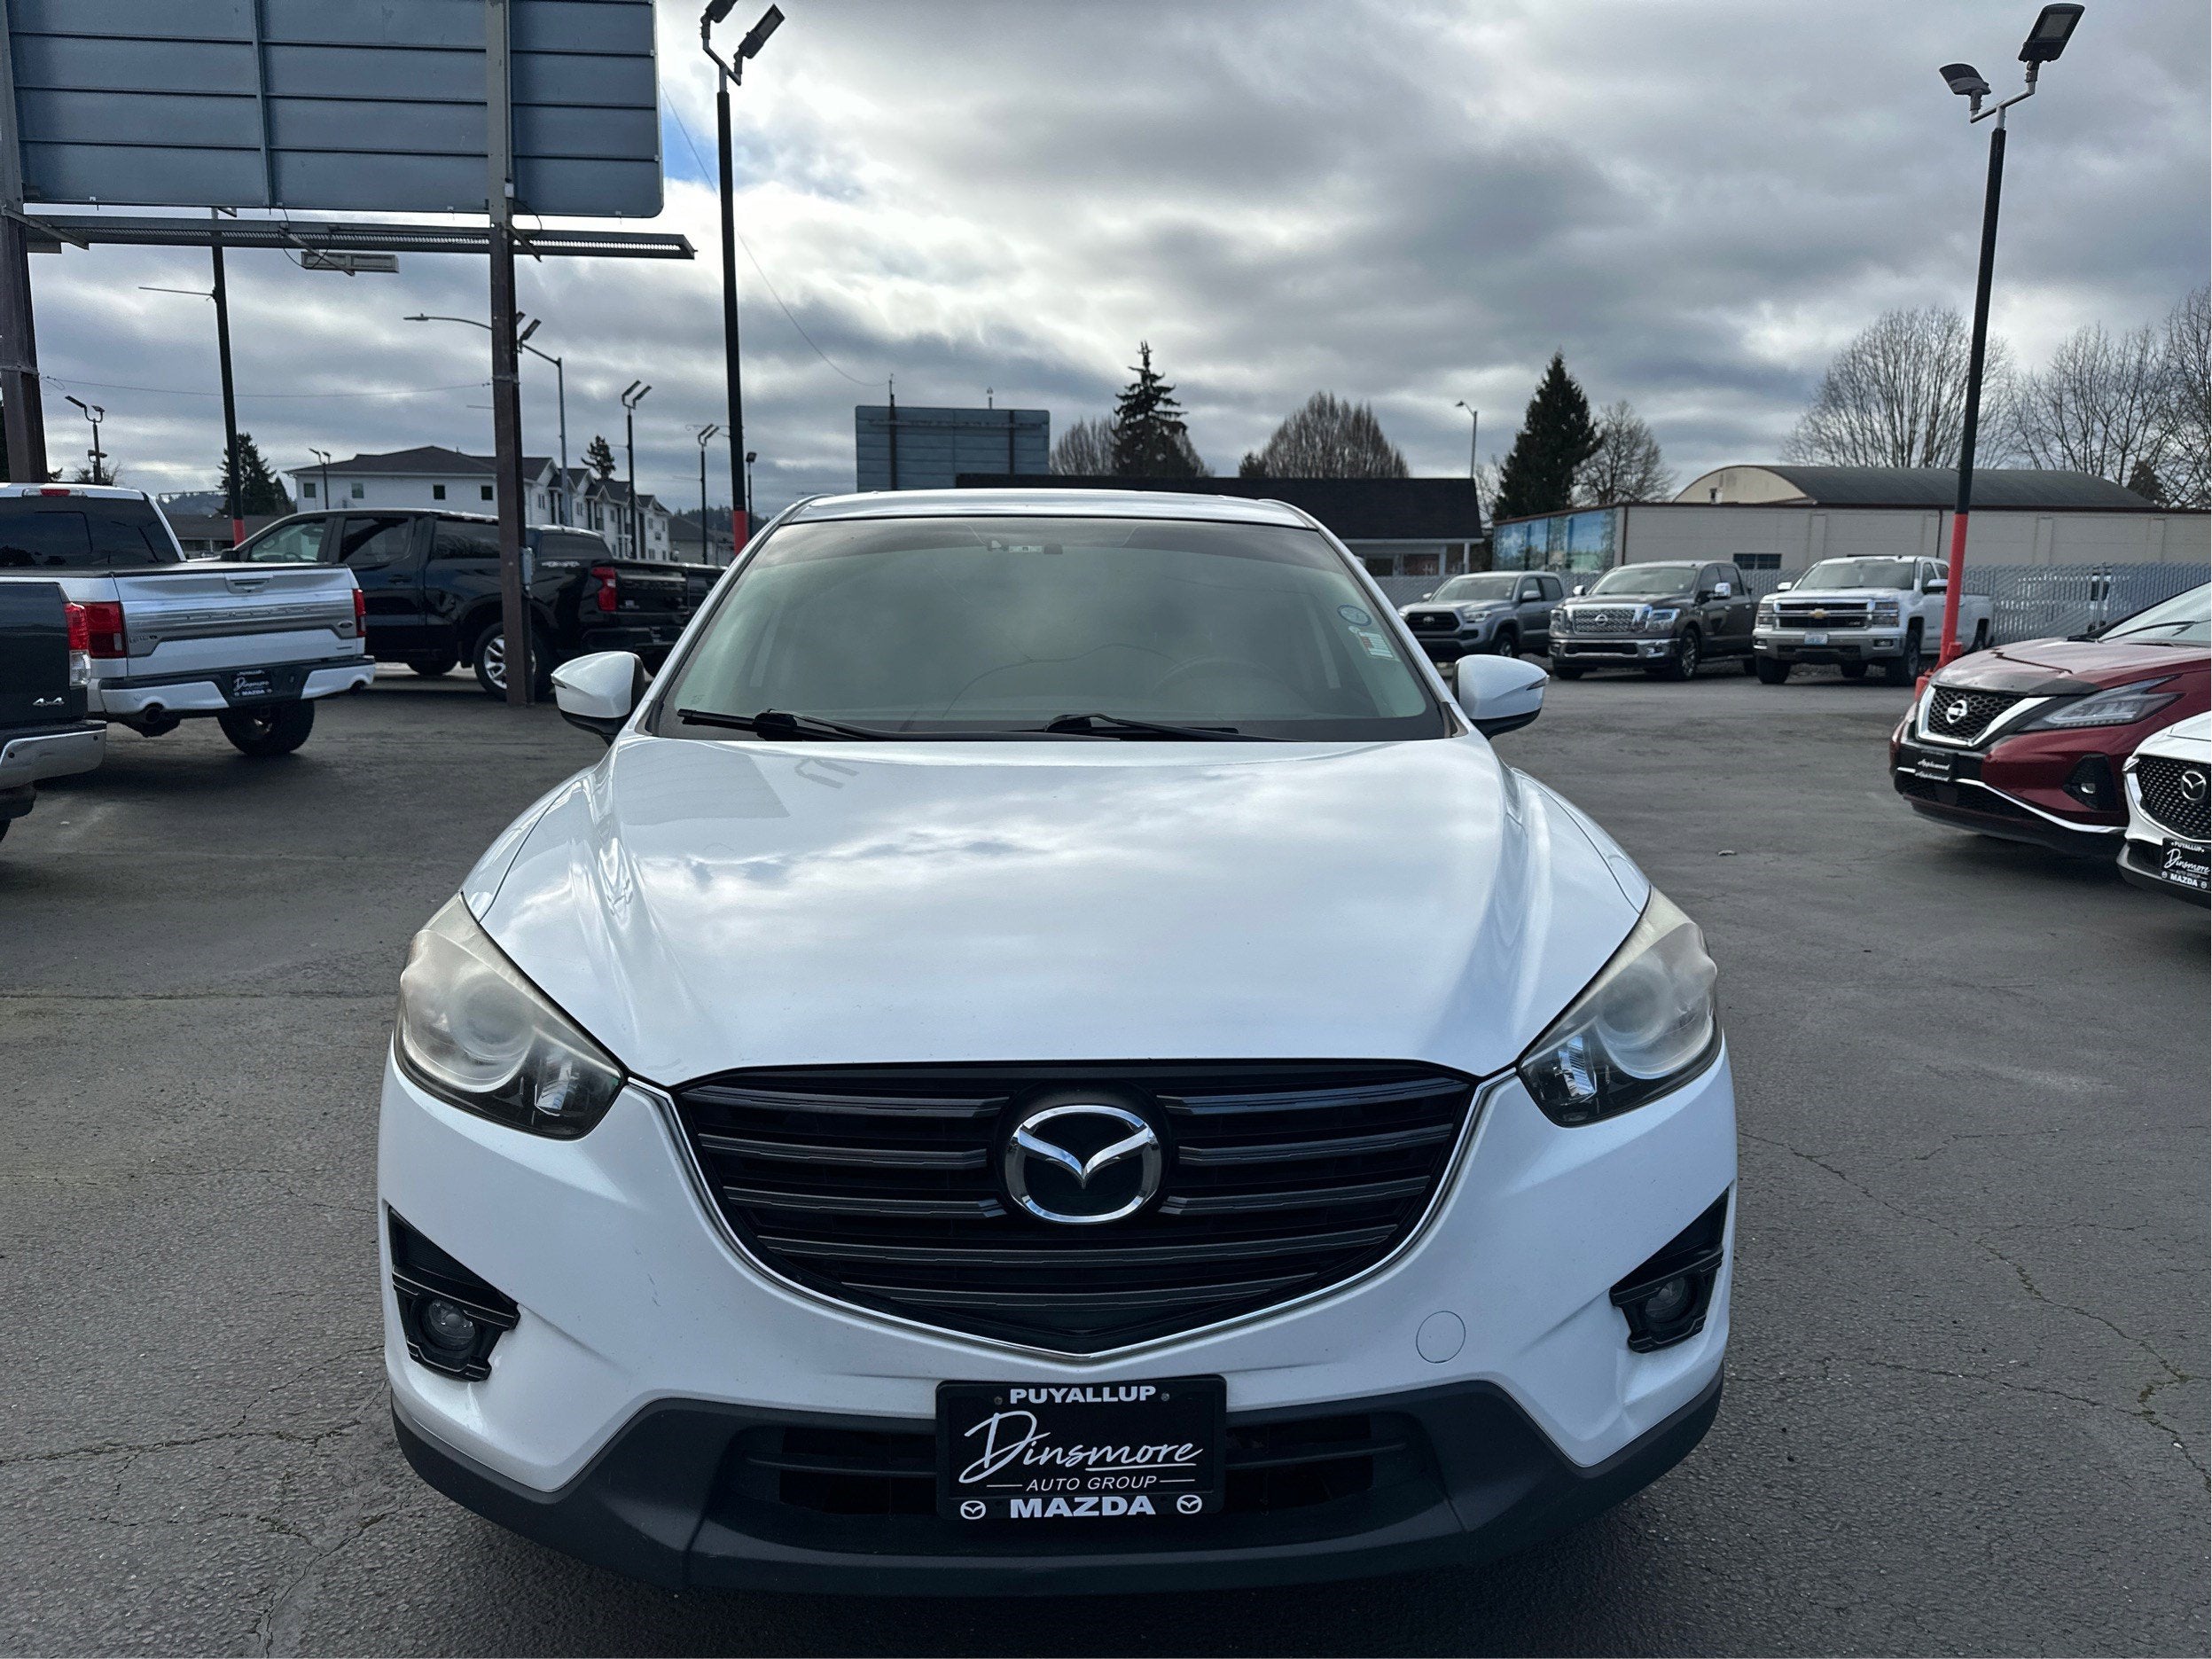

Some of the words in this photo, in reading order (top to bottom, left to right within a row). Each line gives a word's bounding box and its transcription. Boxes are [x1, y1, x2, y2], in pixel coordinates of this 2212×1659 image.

[2174, 841, 2202, 852] PUYALLUP
[2164, 848, 2210, 873] Dinsmore
[2170, 873, 2198, 887] MAZDA
[1010, 1386, 1156, 1404] PUYALLUP
[958, 1411, 1203, 1483] Dinsmore
[1026, 1477, 1080, 1491] AUTO
[1087, 1475, 1157, 1490] GROUP
[1010, 1495, 1156, 1519] MAZDA
